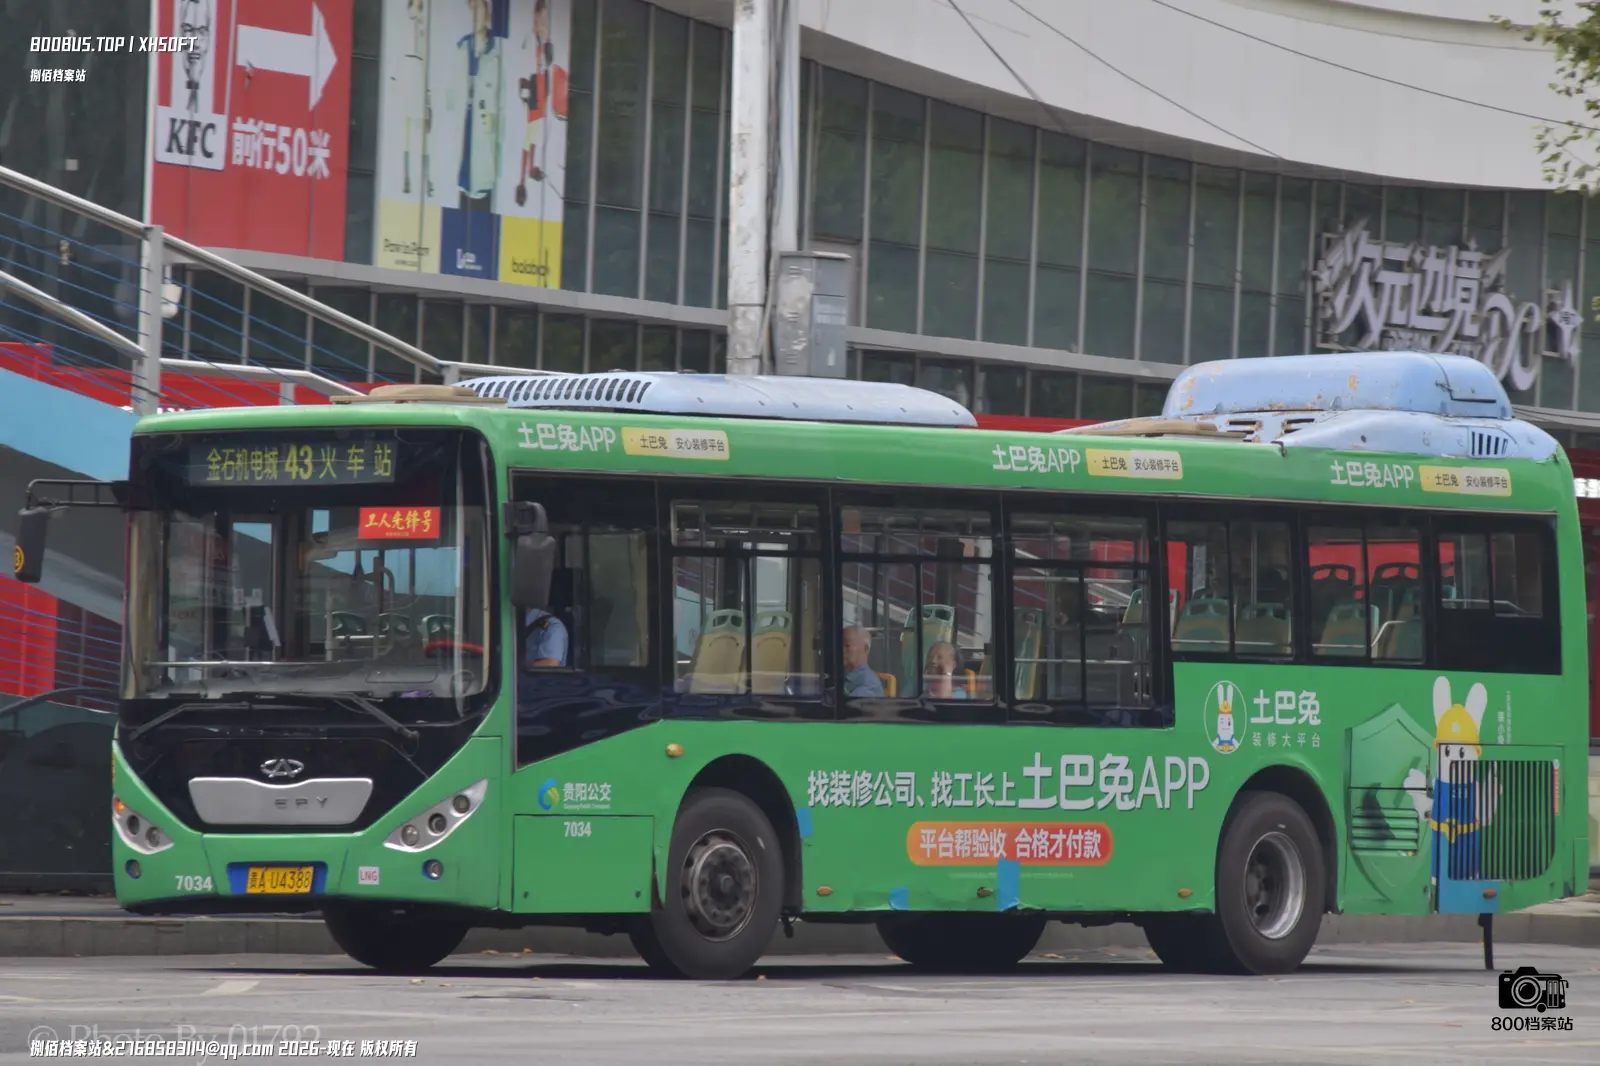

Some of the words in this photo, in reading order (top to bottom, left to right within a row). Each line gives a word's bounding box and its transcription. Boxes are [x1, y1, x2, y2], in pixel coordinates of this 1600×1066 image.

[165, 117, 216, 159] KFC
[232, 116, 332, 180] 前行50米
[517, 422, 617, 453] 土巴兔APP
[639, 434, 669, 450] 土巴兔
[675, 436, 725, 453] 安心装修平台
[206, 447, 279, 481] 金石机电城
[284, 444, 313, 480] 43
[319, 443, 392, 479] 火车站
[992, 444, 1081, 474] 土巴兔APP
[1102, 456, 1128, 471] 土巴兔
[1134, 458, 1179, 473] 安心装修平台
[1330, 460, 1415, 489] 土巴兔APP
[1435, 473, 1460, 488] 土巴兔
[1465, 475, 1508, 490] 安心装修平台
[364, 509, 433, 533] 工人先锋号
[1250, 688, 1321, 726] 土巴兔
[1252, 731, 1321, 748] 装修大平台
[563, 782, 611, 802] 贵阳公交
[563, 821, 592, 837] 7034
[919, 828, 1007, 859] 平台帮验收
[1014, 828, 1102, 859] 合格才付款
[174, 875, 213, 891] 7034
[360, 869, 378, 882] LNG
